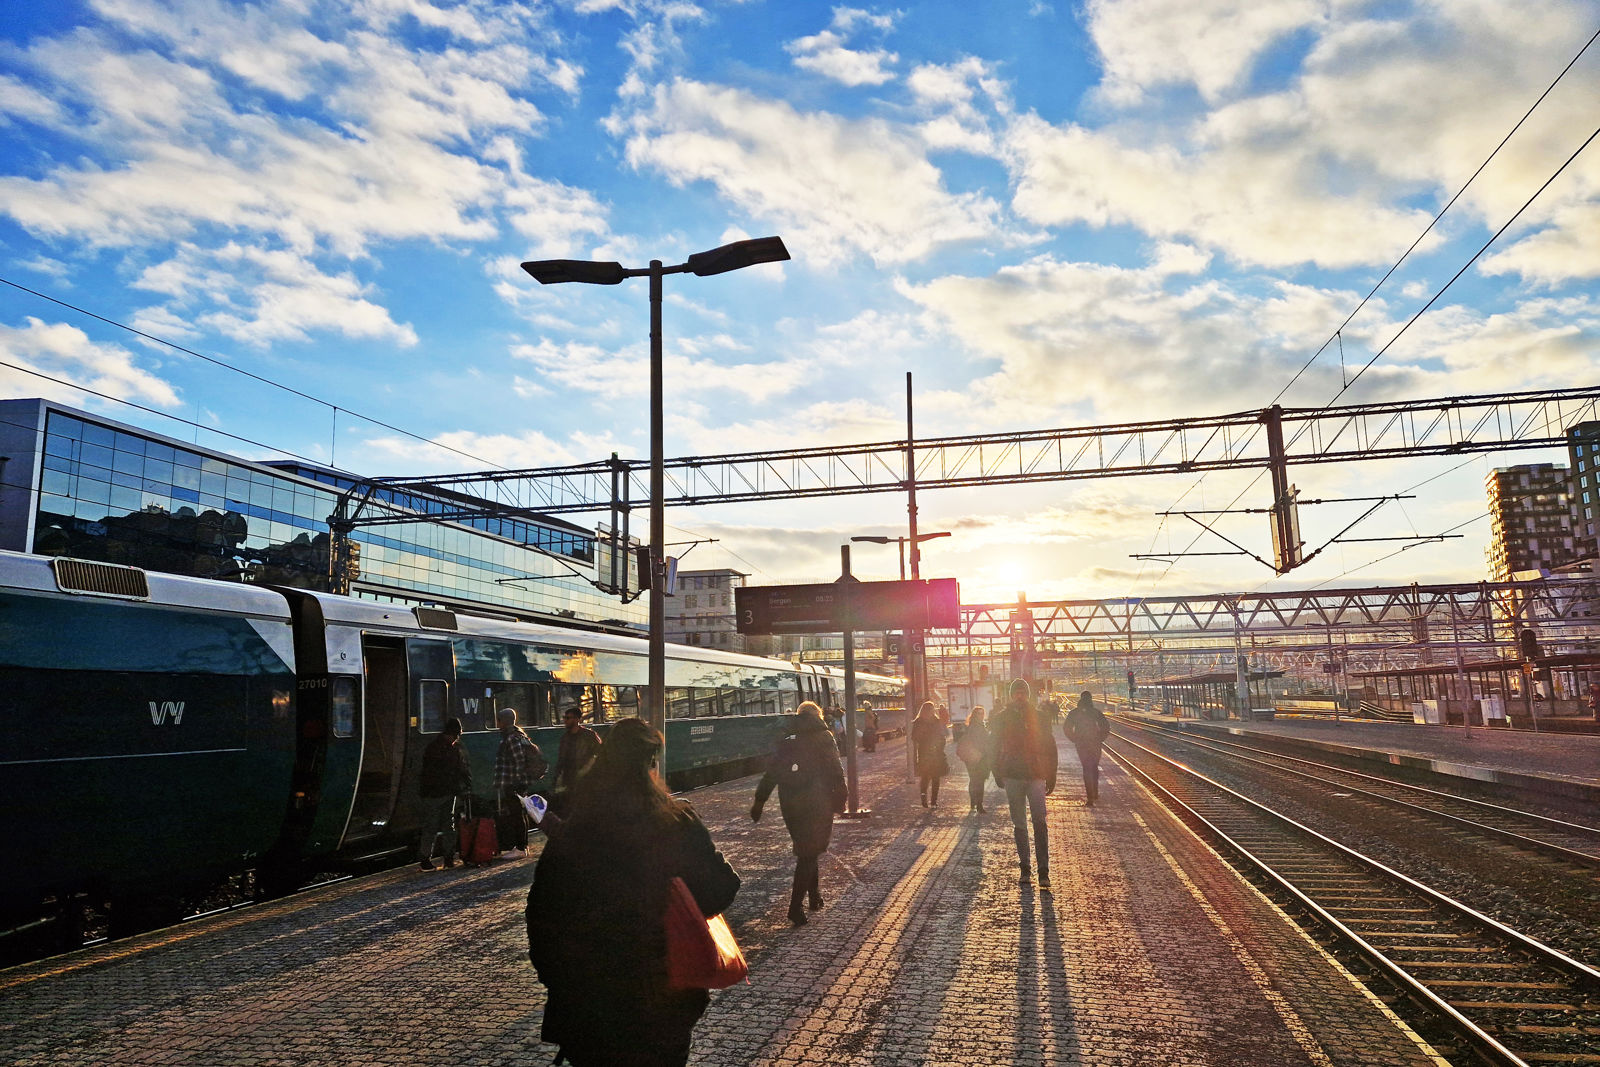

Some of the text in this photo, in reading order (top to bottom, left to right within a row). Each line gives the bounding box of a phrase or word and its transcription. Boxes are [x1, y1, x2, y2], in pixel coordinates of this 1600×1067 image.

[744, 609, 754, 625] 3
[890, 643, 898, 653] G
[912, 642, 921, 652] G
[298, 678, 328, 690] 27010
